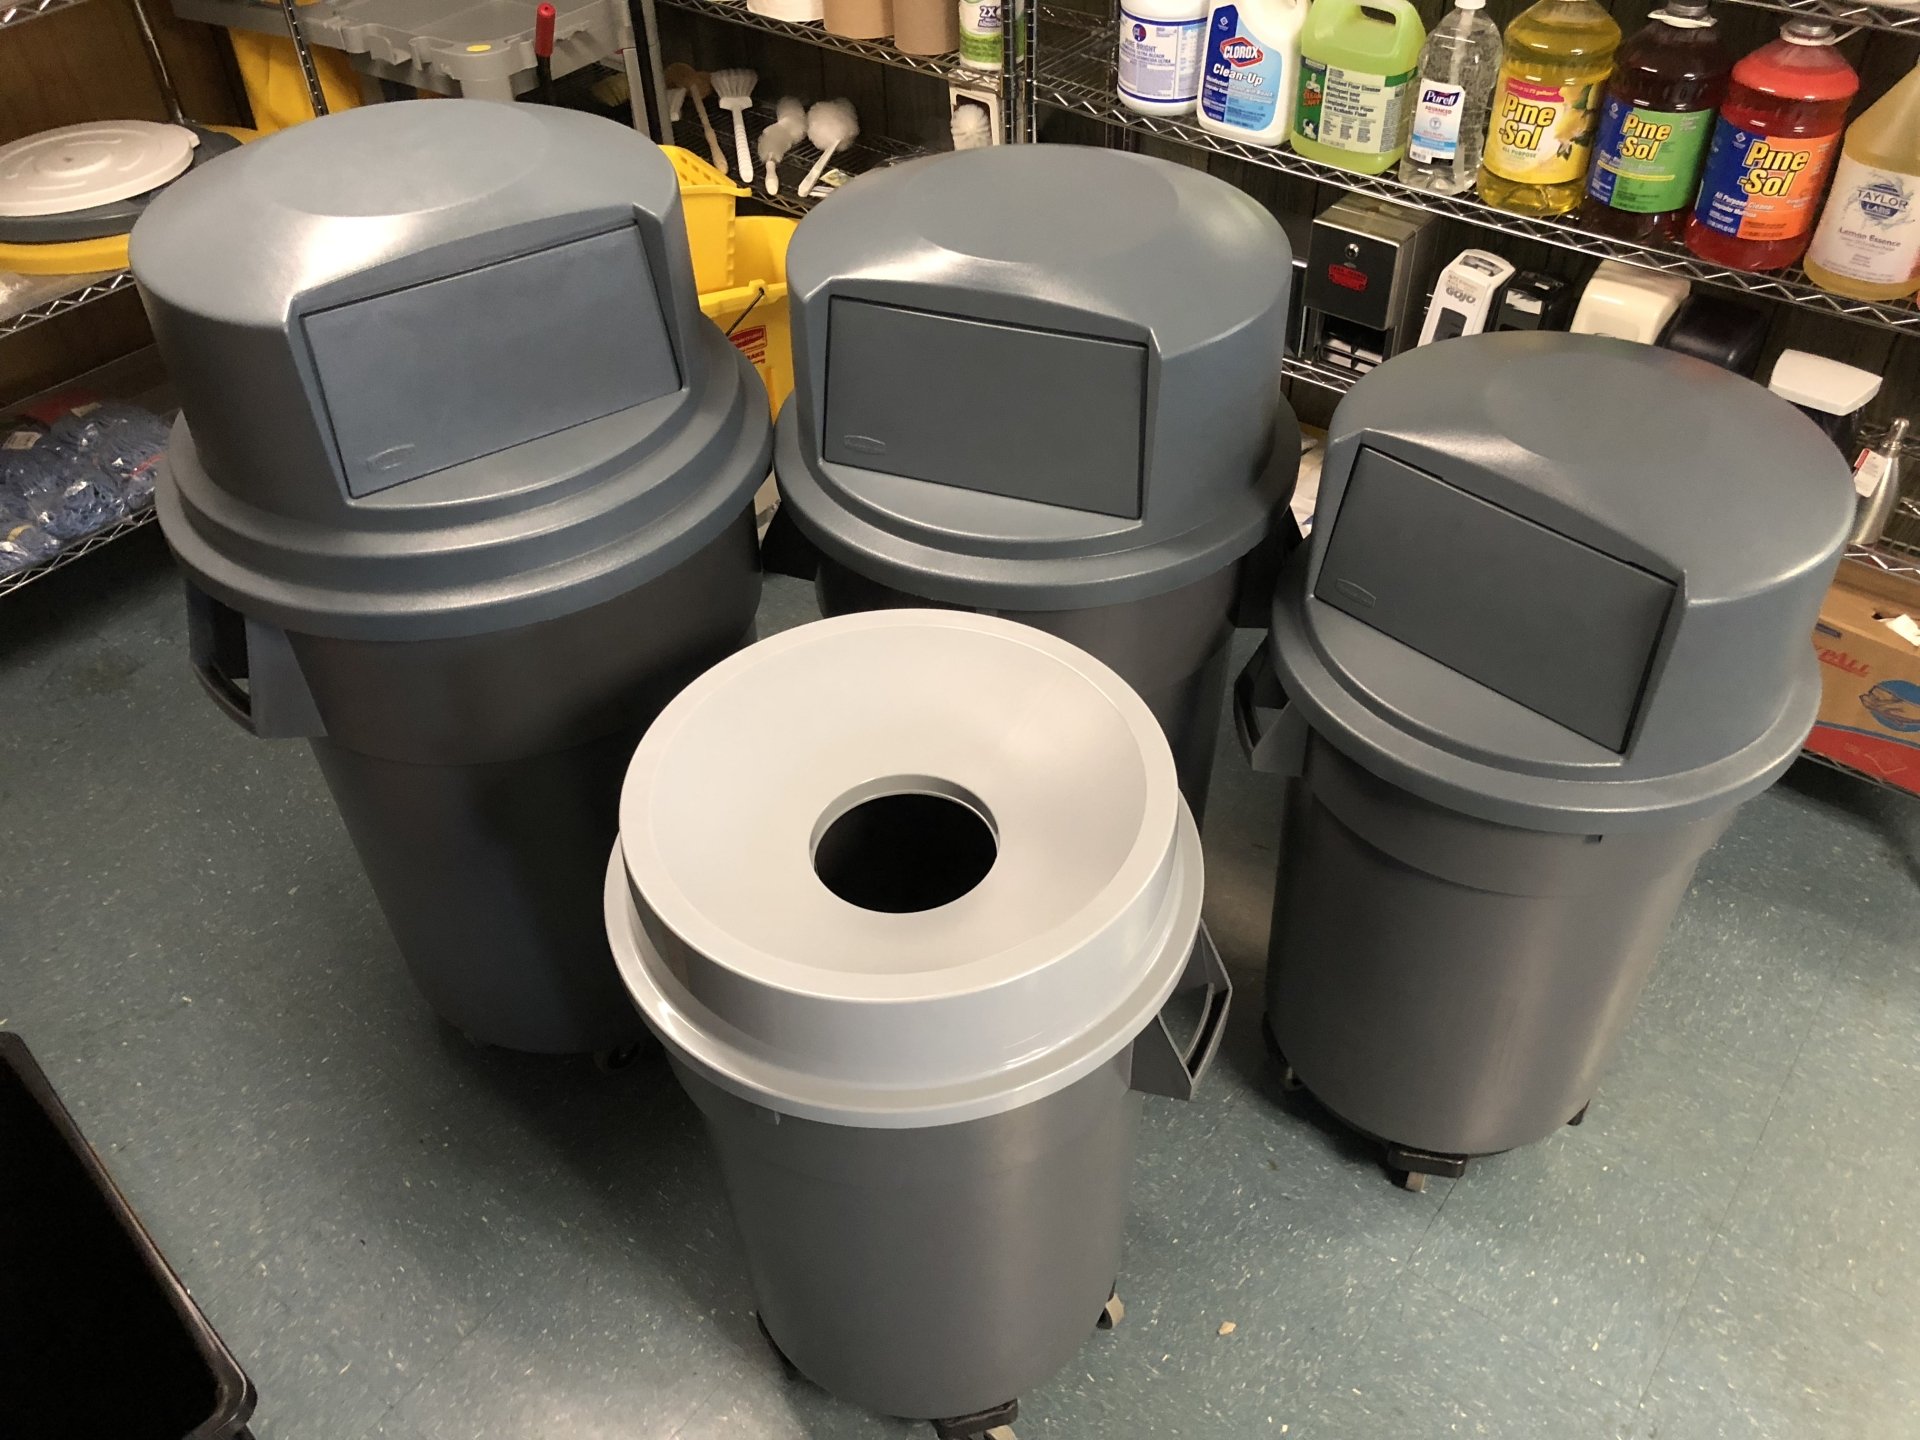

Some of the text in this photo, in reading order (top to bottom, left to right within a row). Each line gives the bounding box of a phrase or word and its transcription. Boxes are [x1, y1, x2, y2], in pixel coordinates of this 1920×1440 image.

[980, 6, 997, 17] 2X
[1223, 45, 1260, 60] CLOROX
[1213, 63, 1263, 87] Clean-Up
[1426, 90, 1456, 106] Purell
[1502, 92, 1556, 127] Pine
[1621, 112, 1672, 141] Pine
[1744, 140, 1811, 172] Pine
[1857, 189, 1908, 209] TAYLOR
[1866, 204, 1891, 215] LABS
[1839, 226, 1867, 240] Lemon
[1869, 234, 1901, 247] Essence
[1446, 286, 1476, 304] GOJO
